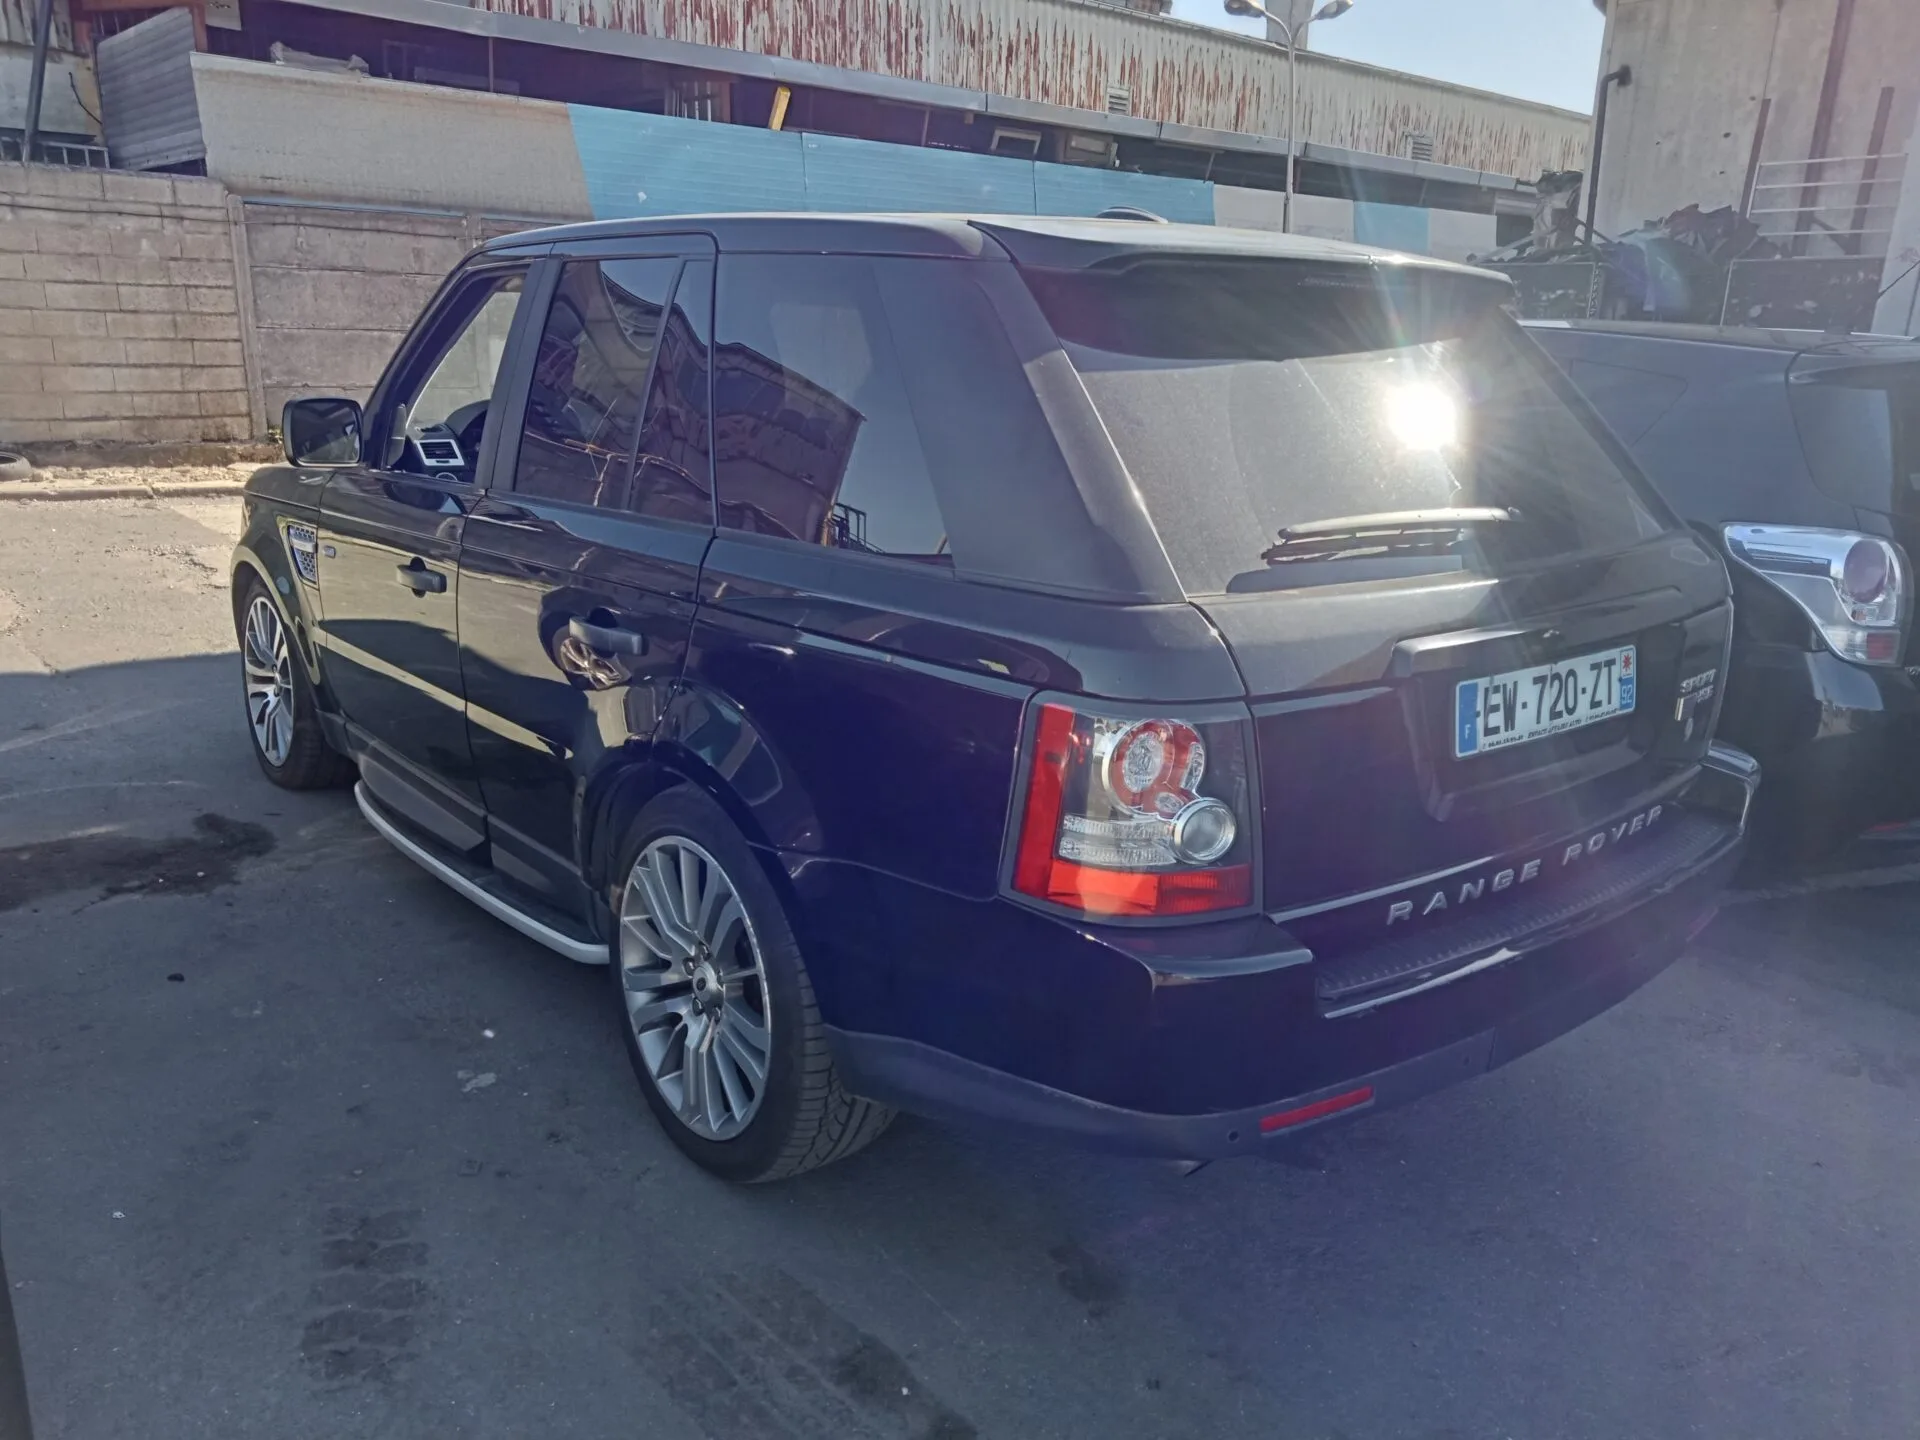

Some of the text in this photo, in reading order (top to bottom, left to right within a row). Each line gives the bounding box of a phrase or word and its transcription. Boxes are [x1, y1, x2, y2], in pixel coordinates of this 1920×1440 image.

[1483, 657, 1617, 738] EW-720-ZT
[1621, 684, 1633, 705] 92
[1464, 723, 1472, 740] F
[1386, 804, 1663, 926] RANGE ROVER
